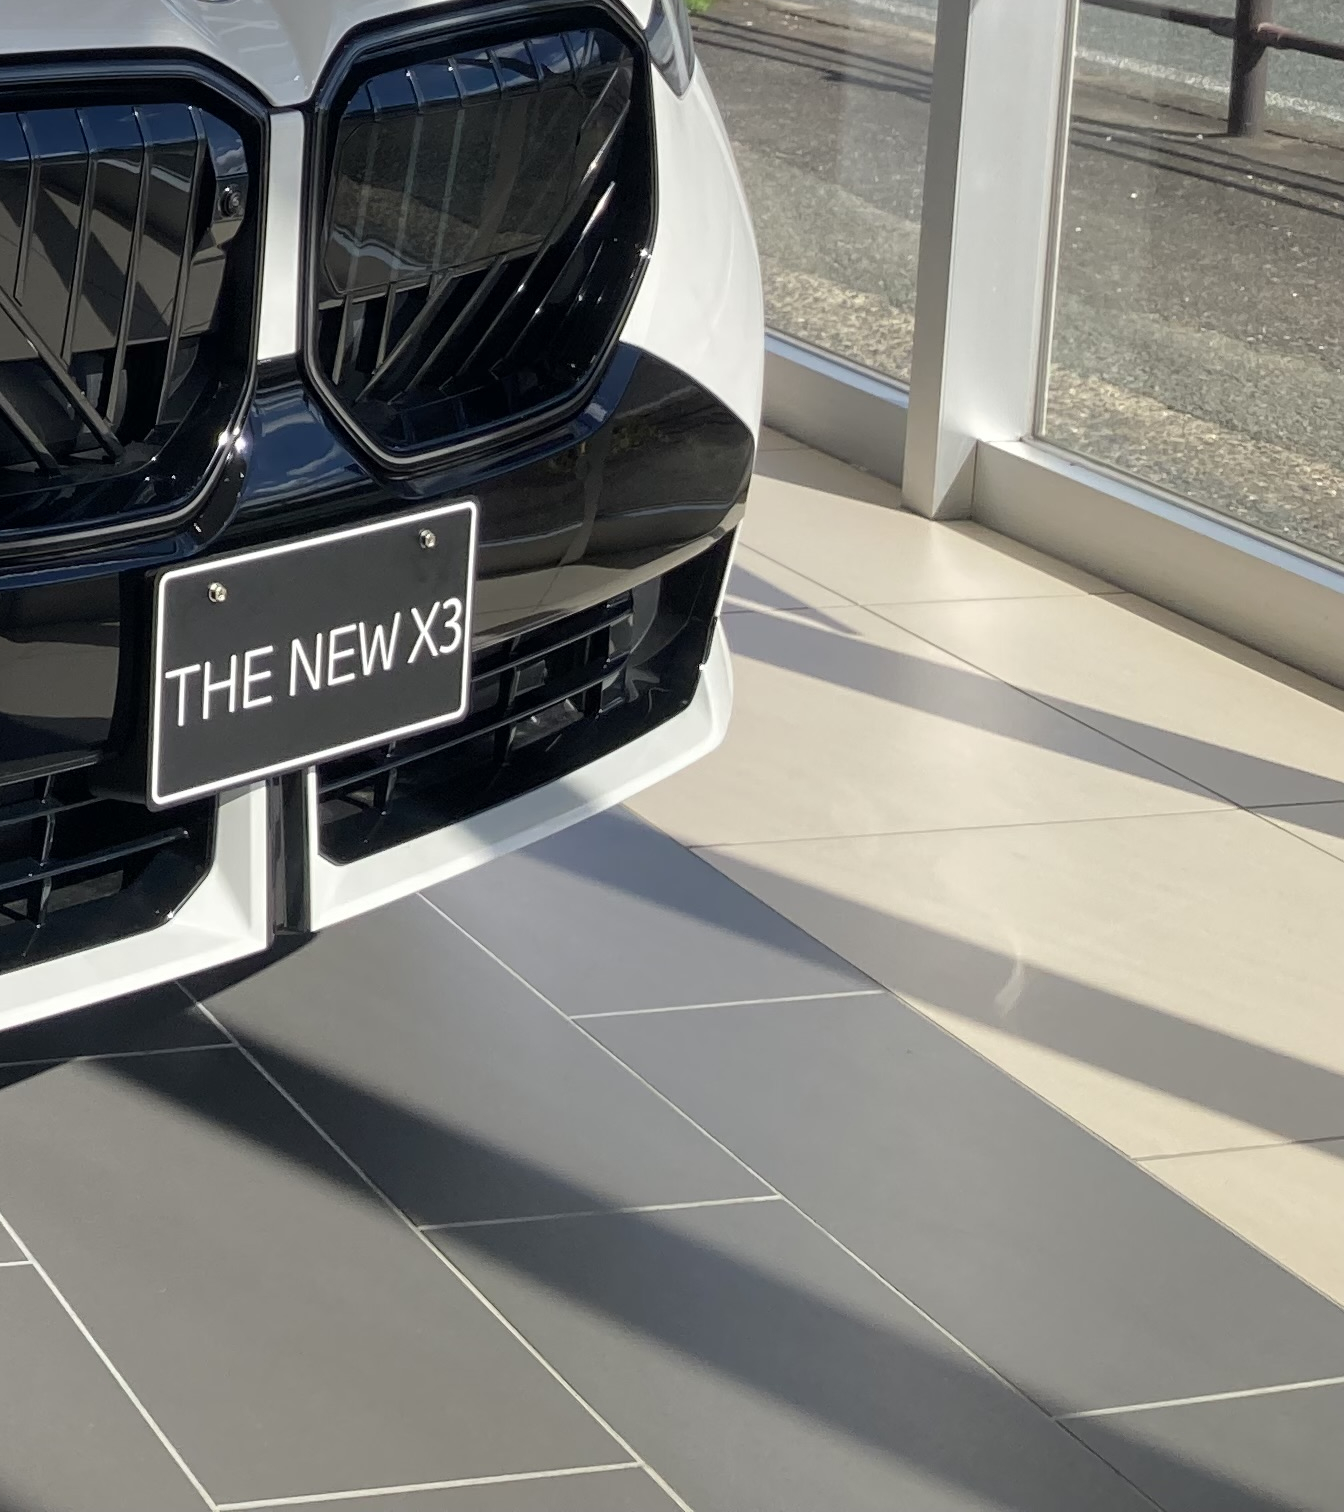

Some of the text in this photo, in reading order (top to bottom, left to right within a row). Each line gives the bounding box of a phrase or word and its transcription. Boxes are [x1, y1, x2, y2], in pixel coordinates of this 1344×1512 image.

[165, 597, 463, 727] THE NEW X3
